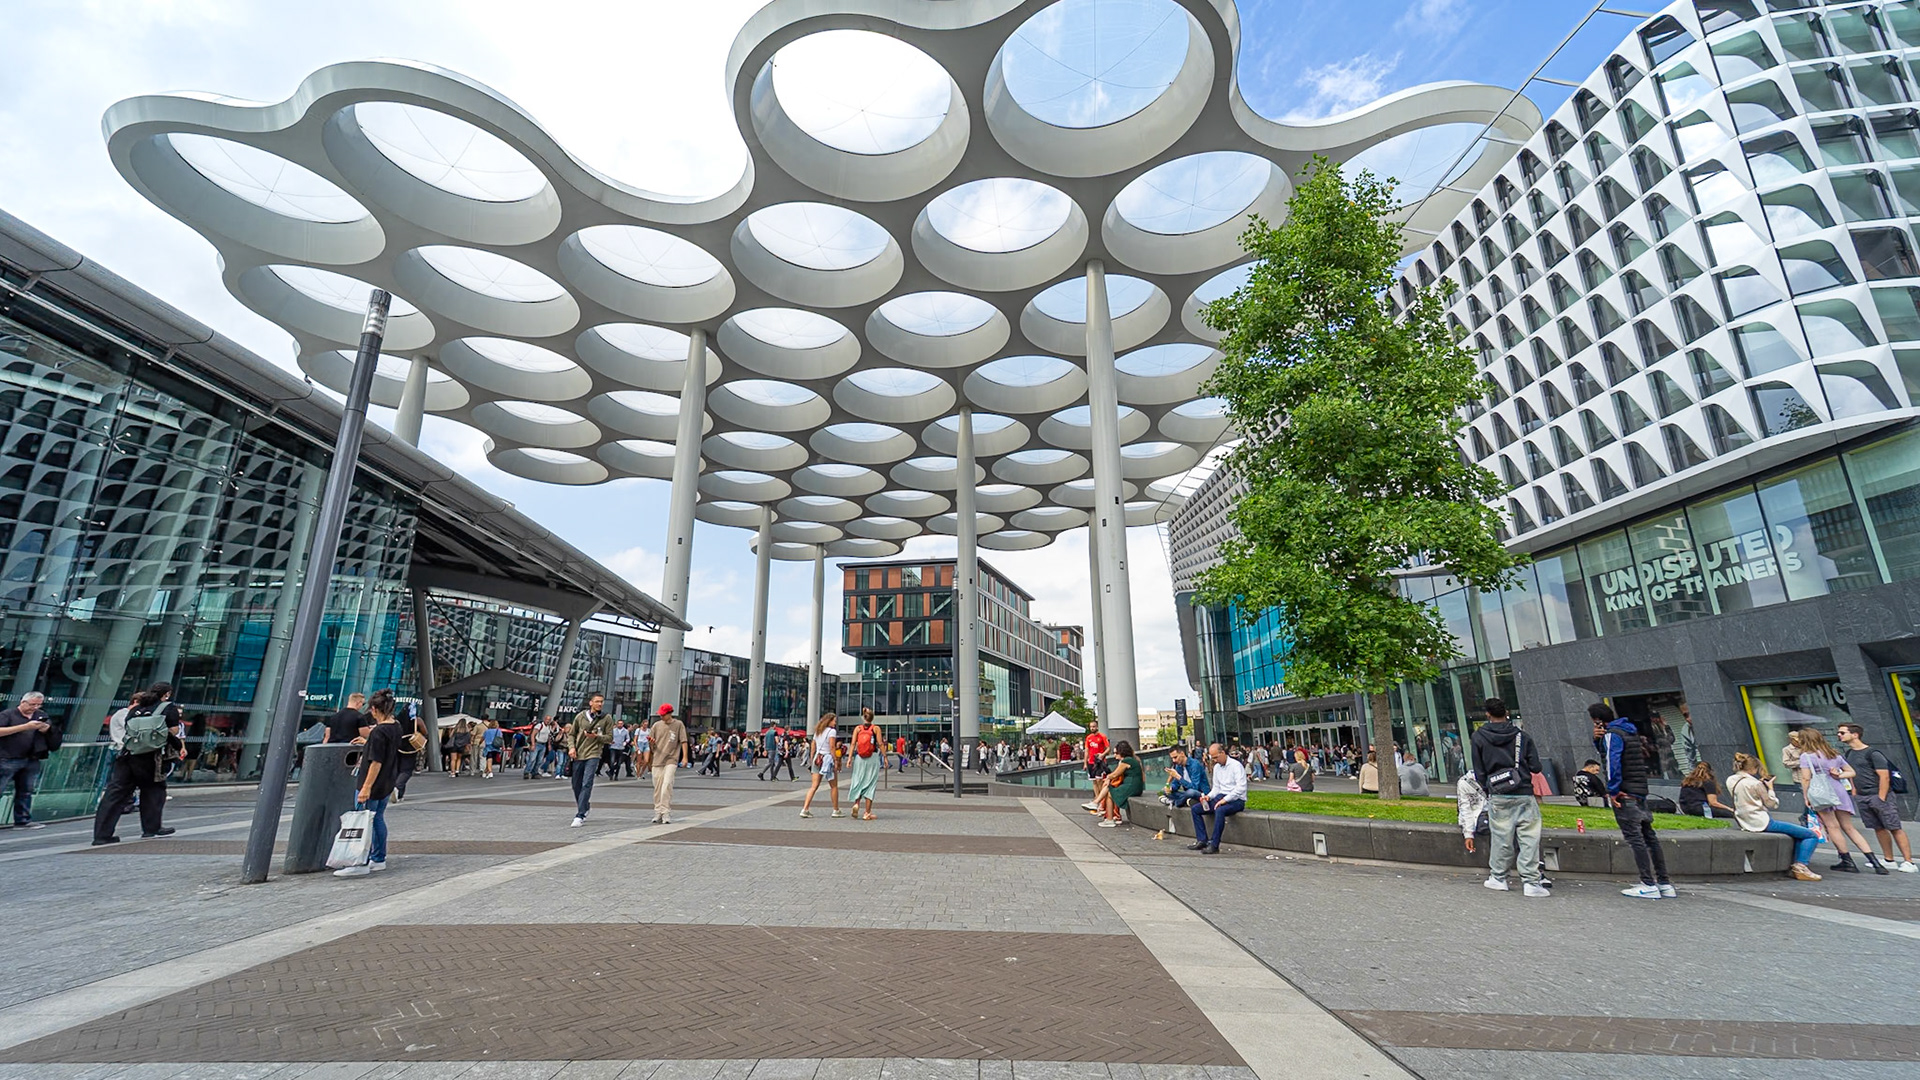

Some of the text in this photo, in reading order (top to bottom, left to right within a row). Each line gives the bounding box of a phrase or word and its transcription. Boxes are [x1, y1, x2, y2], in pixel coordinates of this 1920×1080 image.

[1599, 525, 1793, 595] UNDISPUTED
[1604, 552, 1802, 612] KING OF TRAINERS
[1252, 686, 1269, 702] HOOG
